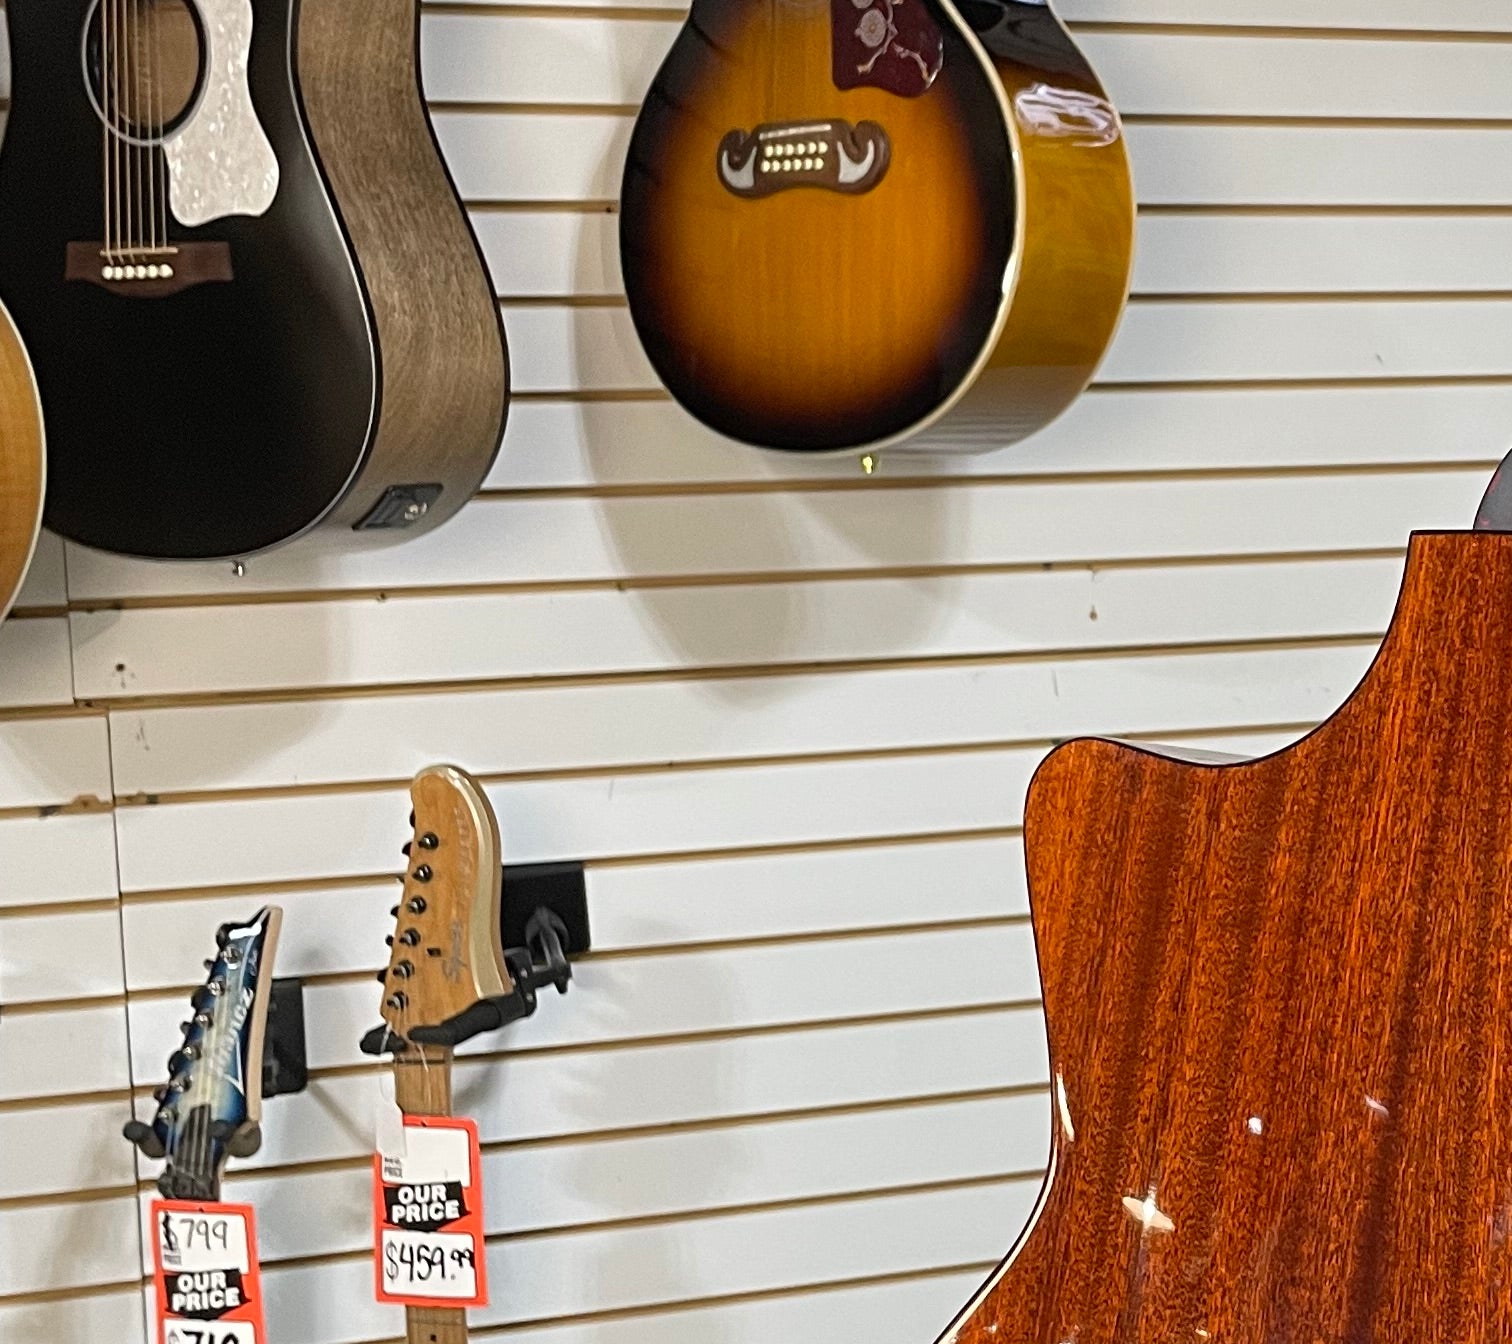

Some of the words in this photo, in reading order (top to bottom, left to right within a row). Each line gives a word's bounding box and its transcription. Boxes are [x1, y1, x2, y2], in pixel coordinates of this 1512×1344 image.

[397, 1184, 447, 1205] OUR
[391, 1200, 461, 1223] PRICE
[176, 1271, 227, 1293] OUR
[171, 1287, 241, 1312] PRICE
